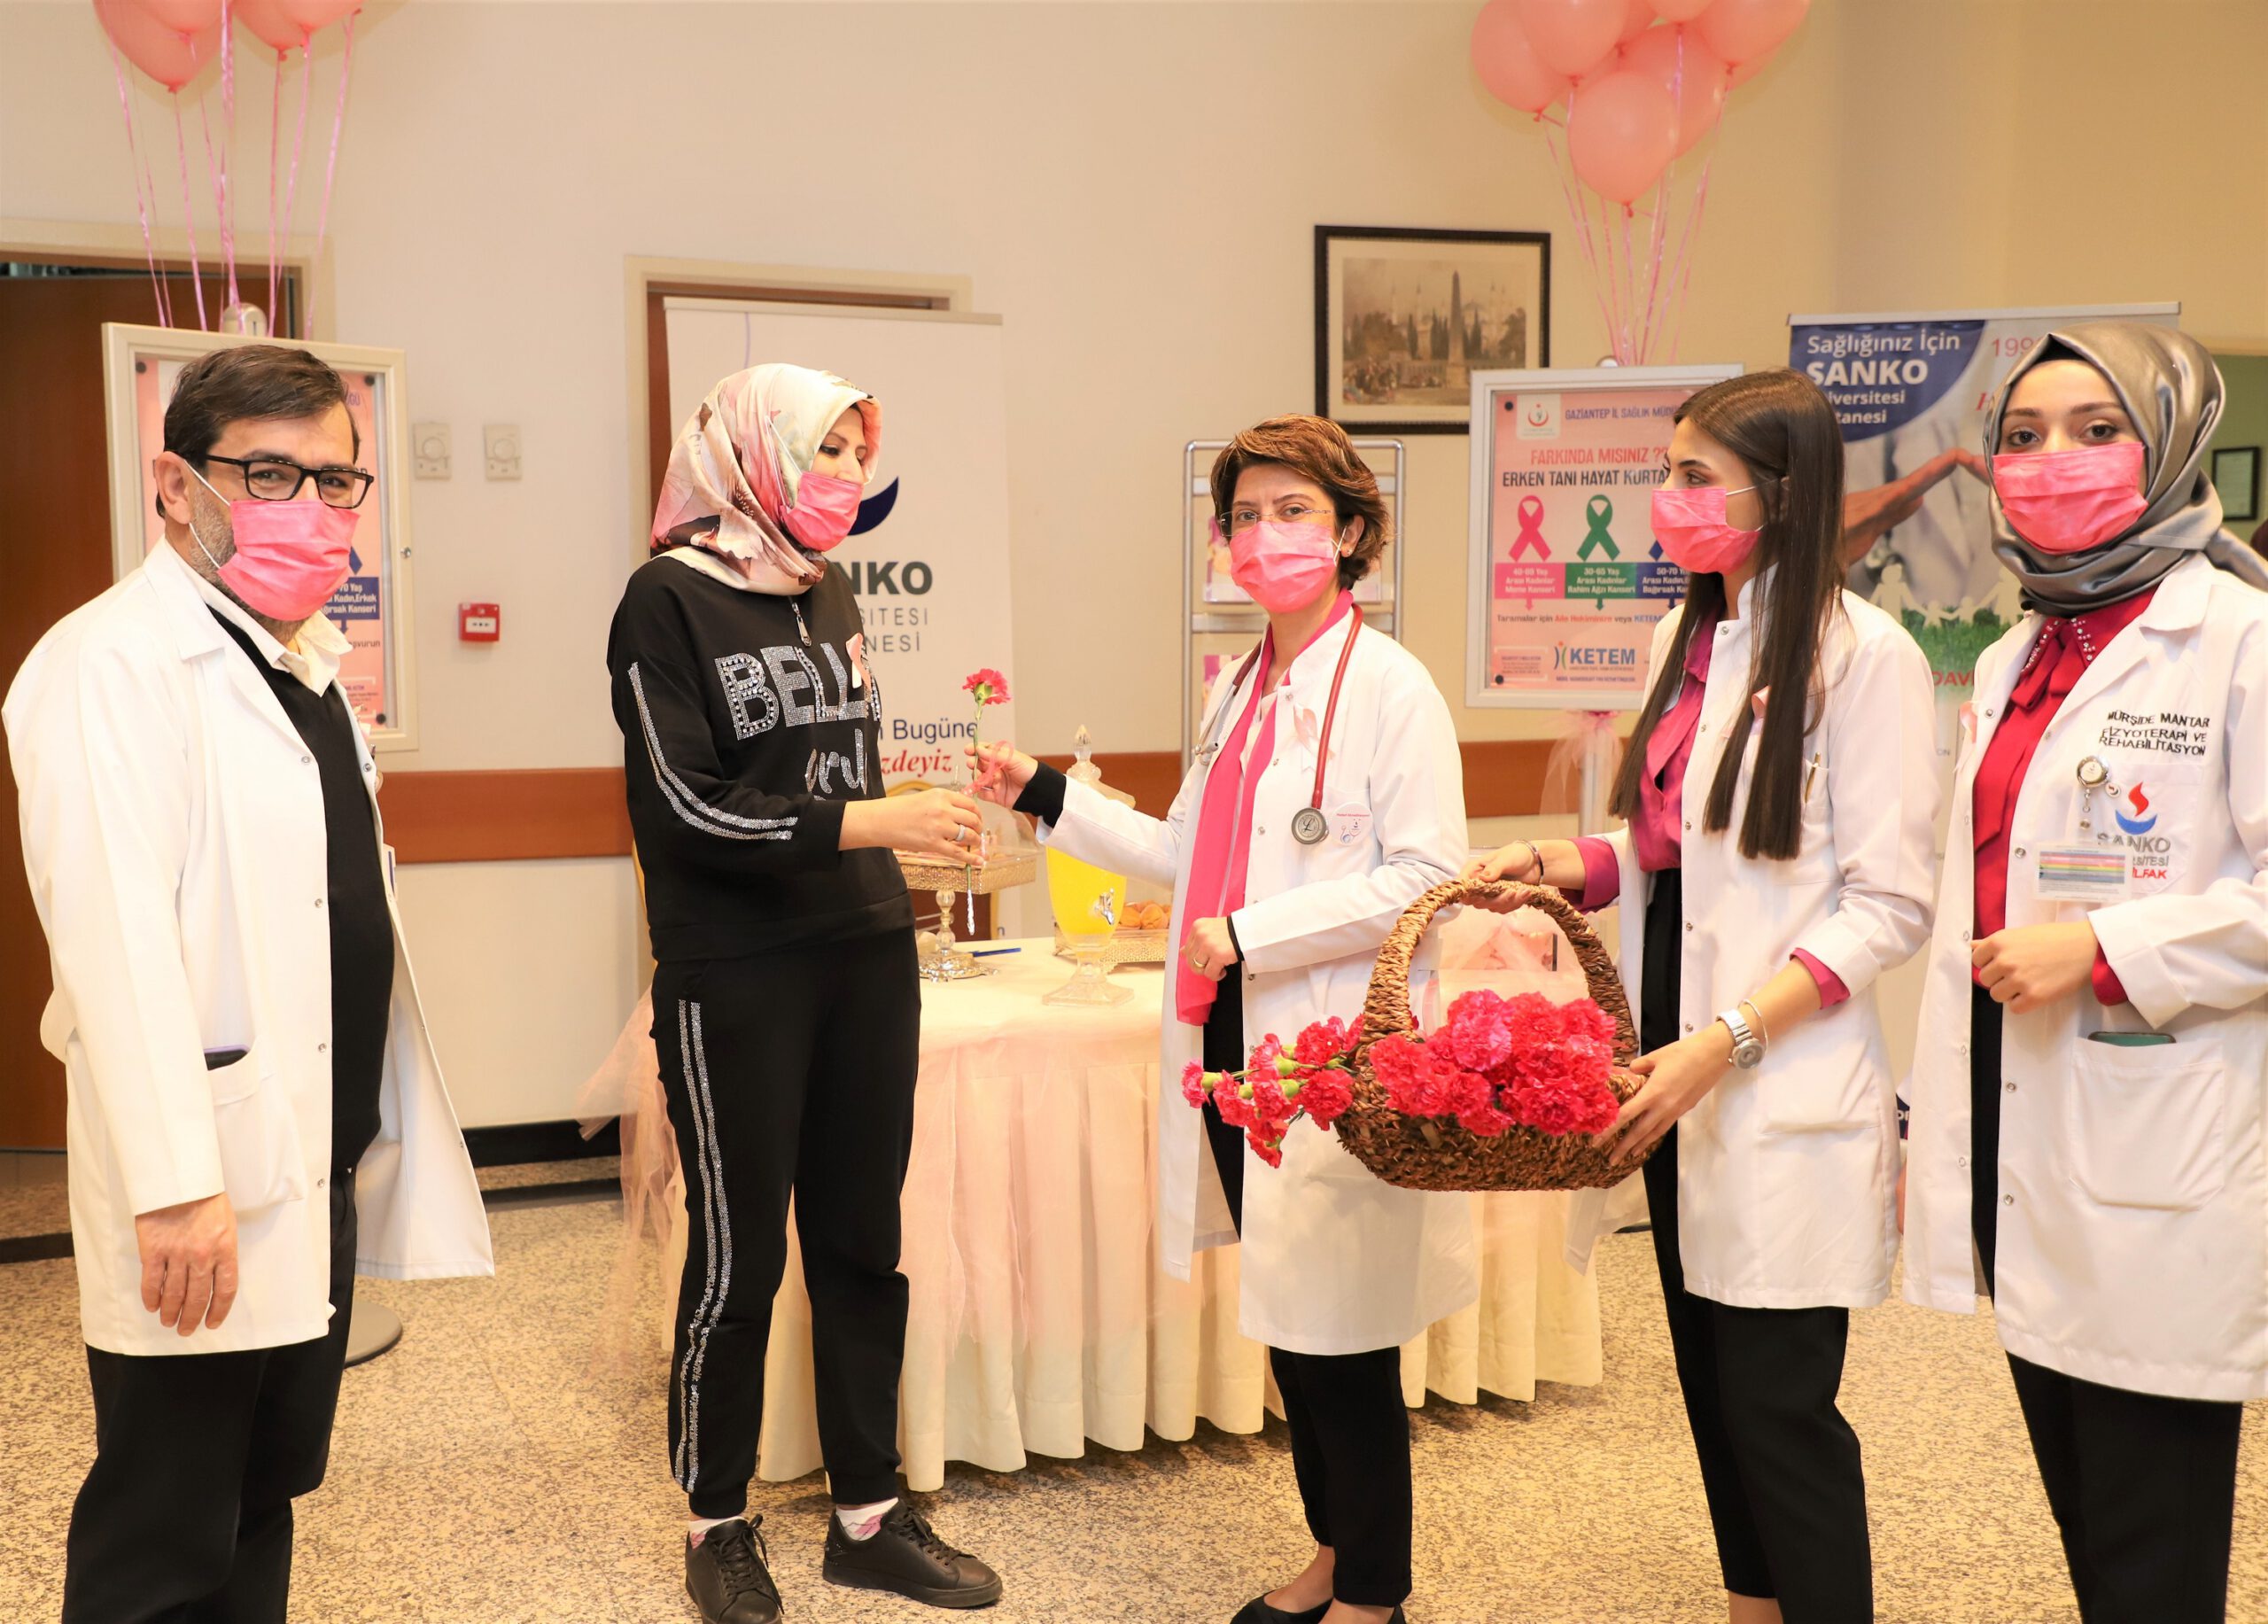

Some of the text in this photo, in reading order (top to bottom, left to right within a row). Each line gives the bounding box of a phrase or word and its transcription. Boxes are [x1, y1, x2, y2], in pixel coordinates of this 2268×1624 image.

[1807, 329, 1961, 358] Sağlığınız İçin
[1806, 359, 1929, 386] SANKO
[1828, 390, 1906, 405] iversitesi
[1565, 407, 1611, 420] GAZİANTEP
[1612, 405, 1620, 419] İL
[1621, 405, 1651, 418] SAĞLIK
[1835, 409, 1887, 423] tanesi
[1531, 449, 1595, 466] FARKINDA
[1598, 447, 1650, 464] MISINIZ
[1503, 469, 1671, 487] ERKEN TANI HAYAT KURTA
[832, 561, 933, 595] NKO
[322, 604, 347, 616] ğırsak
[865, 631, 920, 652] NESİ
[1570, 648, 1635, 665] KETEM
[2160, 712, 2210, 727] MANTAR
[2101, 727, 2207, 742] FİZYOTERAPİ VE
[2099, 736, 2206, 756] REHABİLİTASYON
